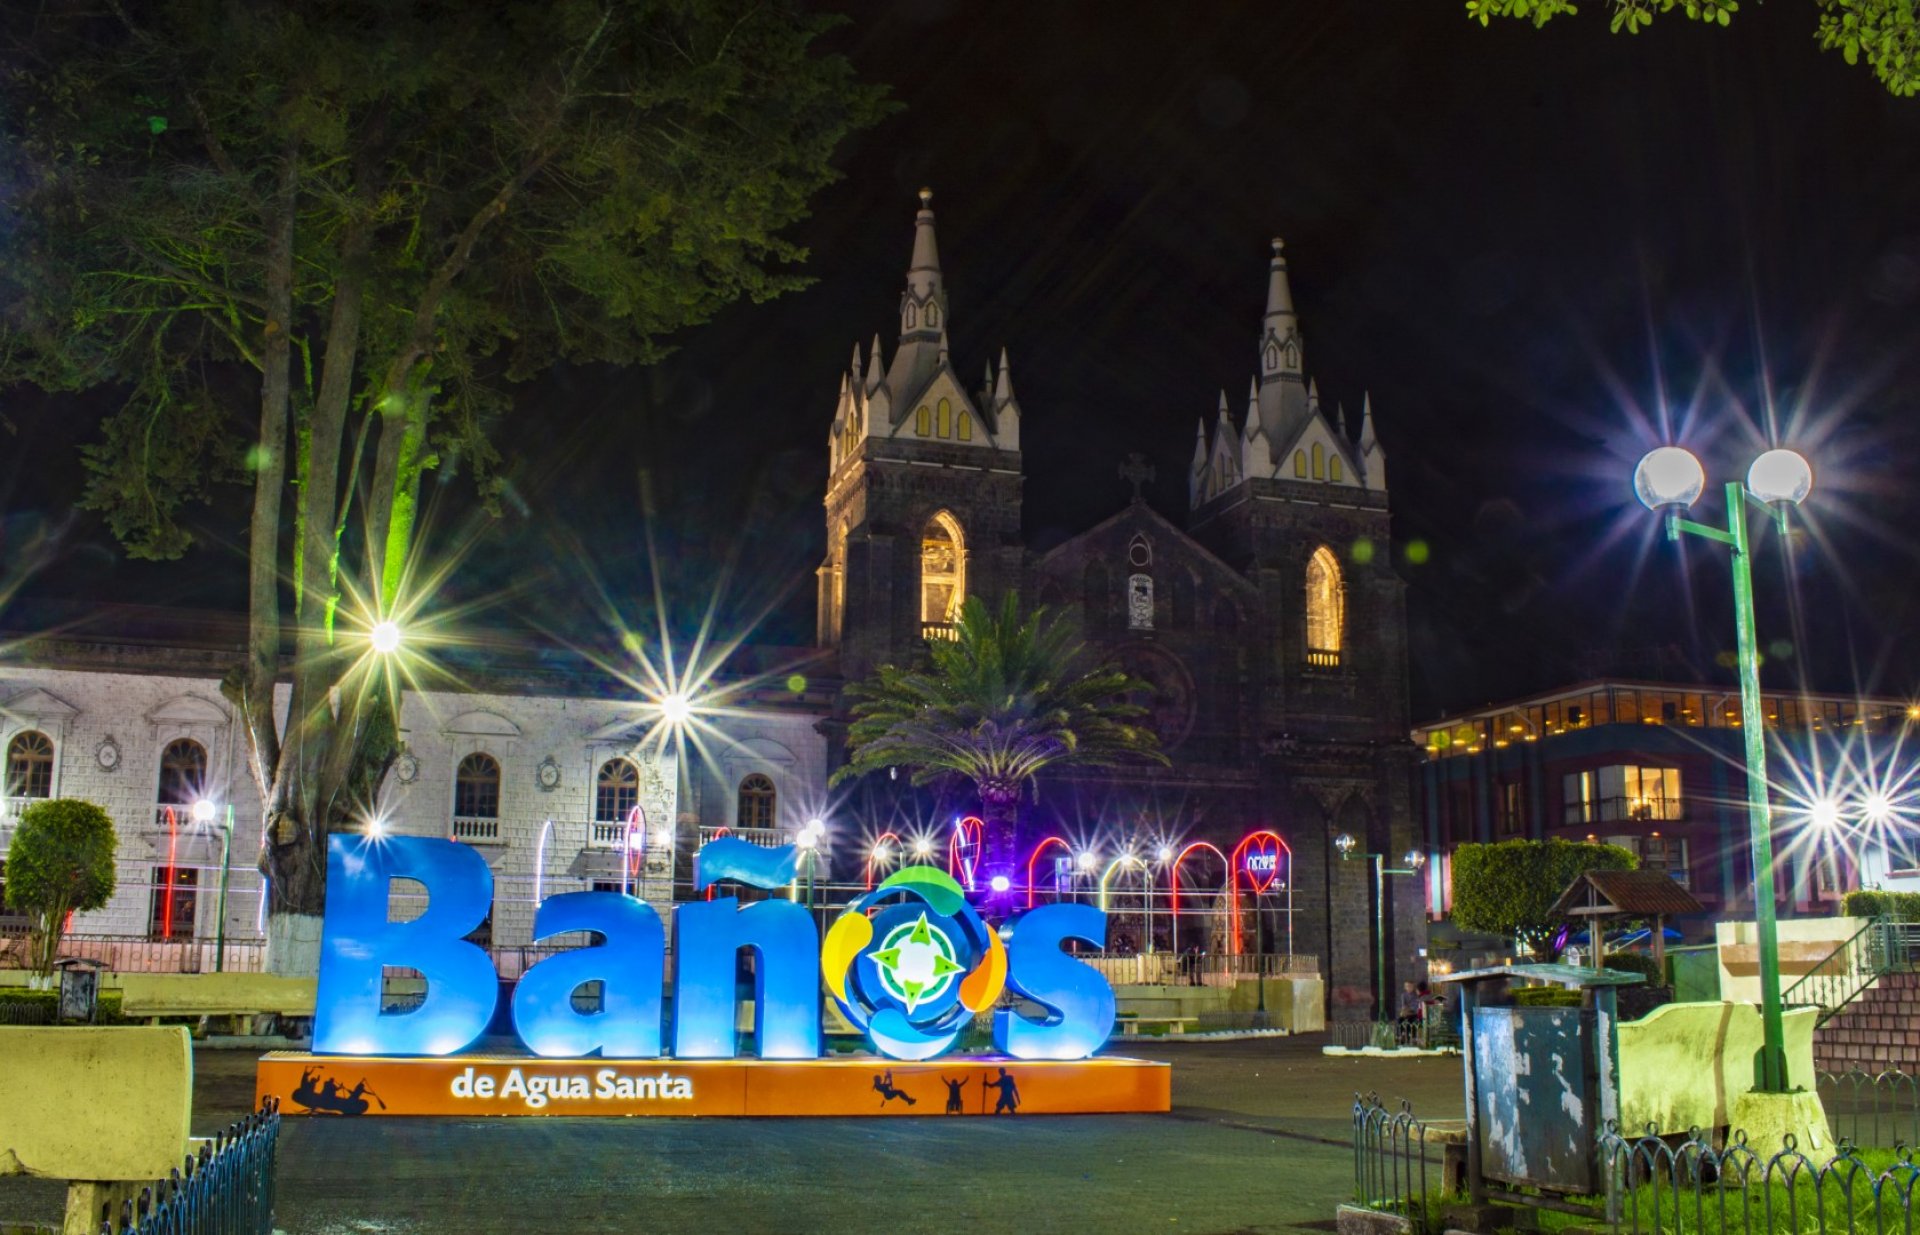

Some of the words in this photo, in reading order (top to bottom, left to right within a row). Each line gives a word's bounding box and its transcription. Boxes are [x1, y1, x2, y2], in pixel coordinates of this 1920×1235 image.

[312, 834, 1116, 1060] Baños
[450, 1067, 495, 1098] de
[500, 1068, 591, 1108] Agua
[595, 1069, 694, 1099] Santa
